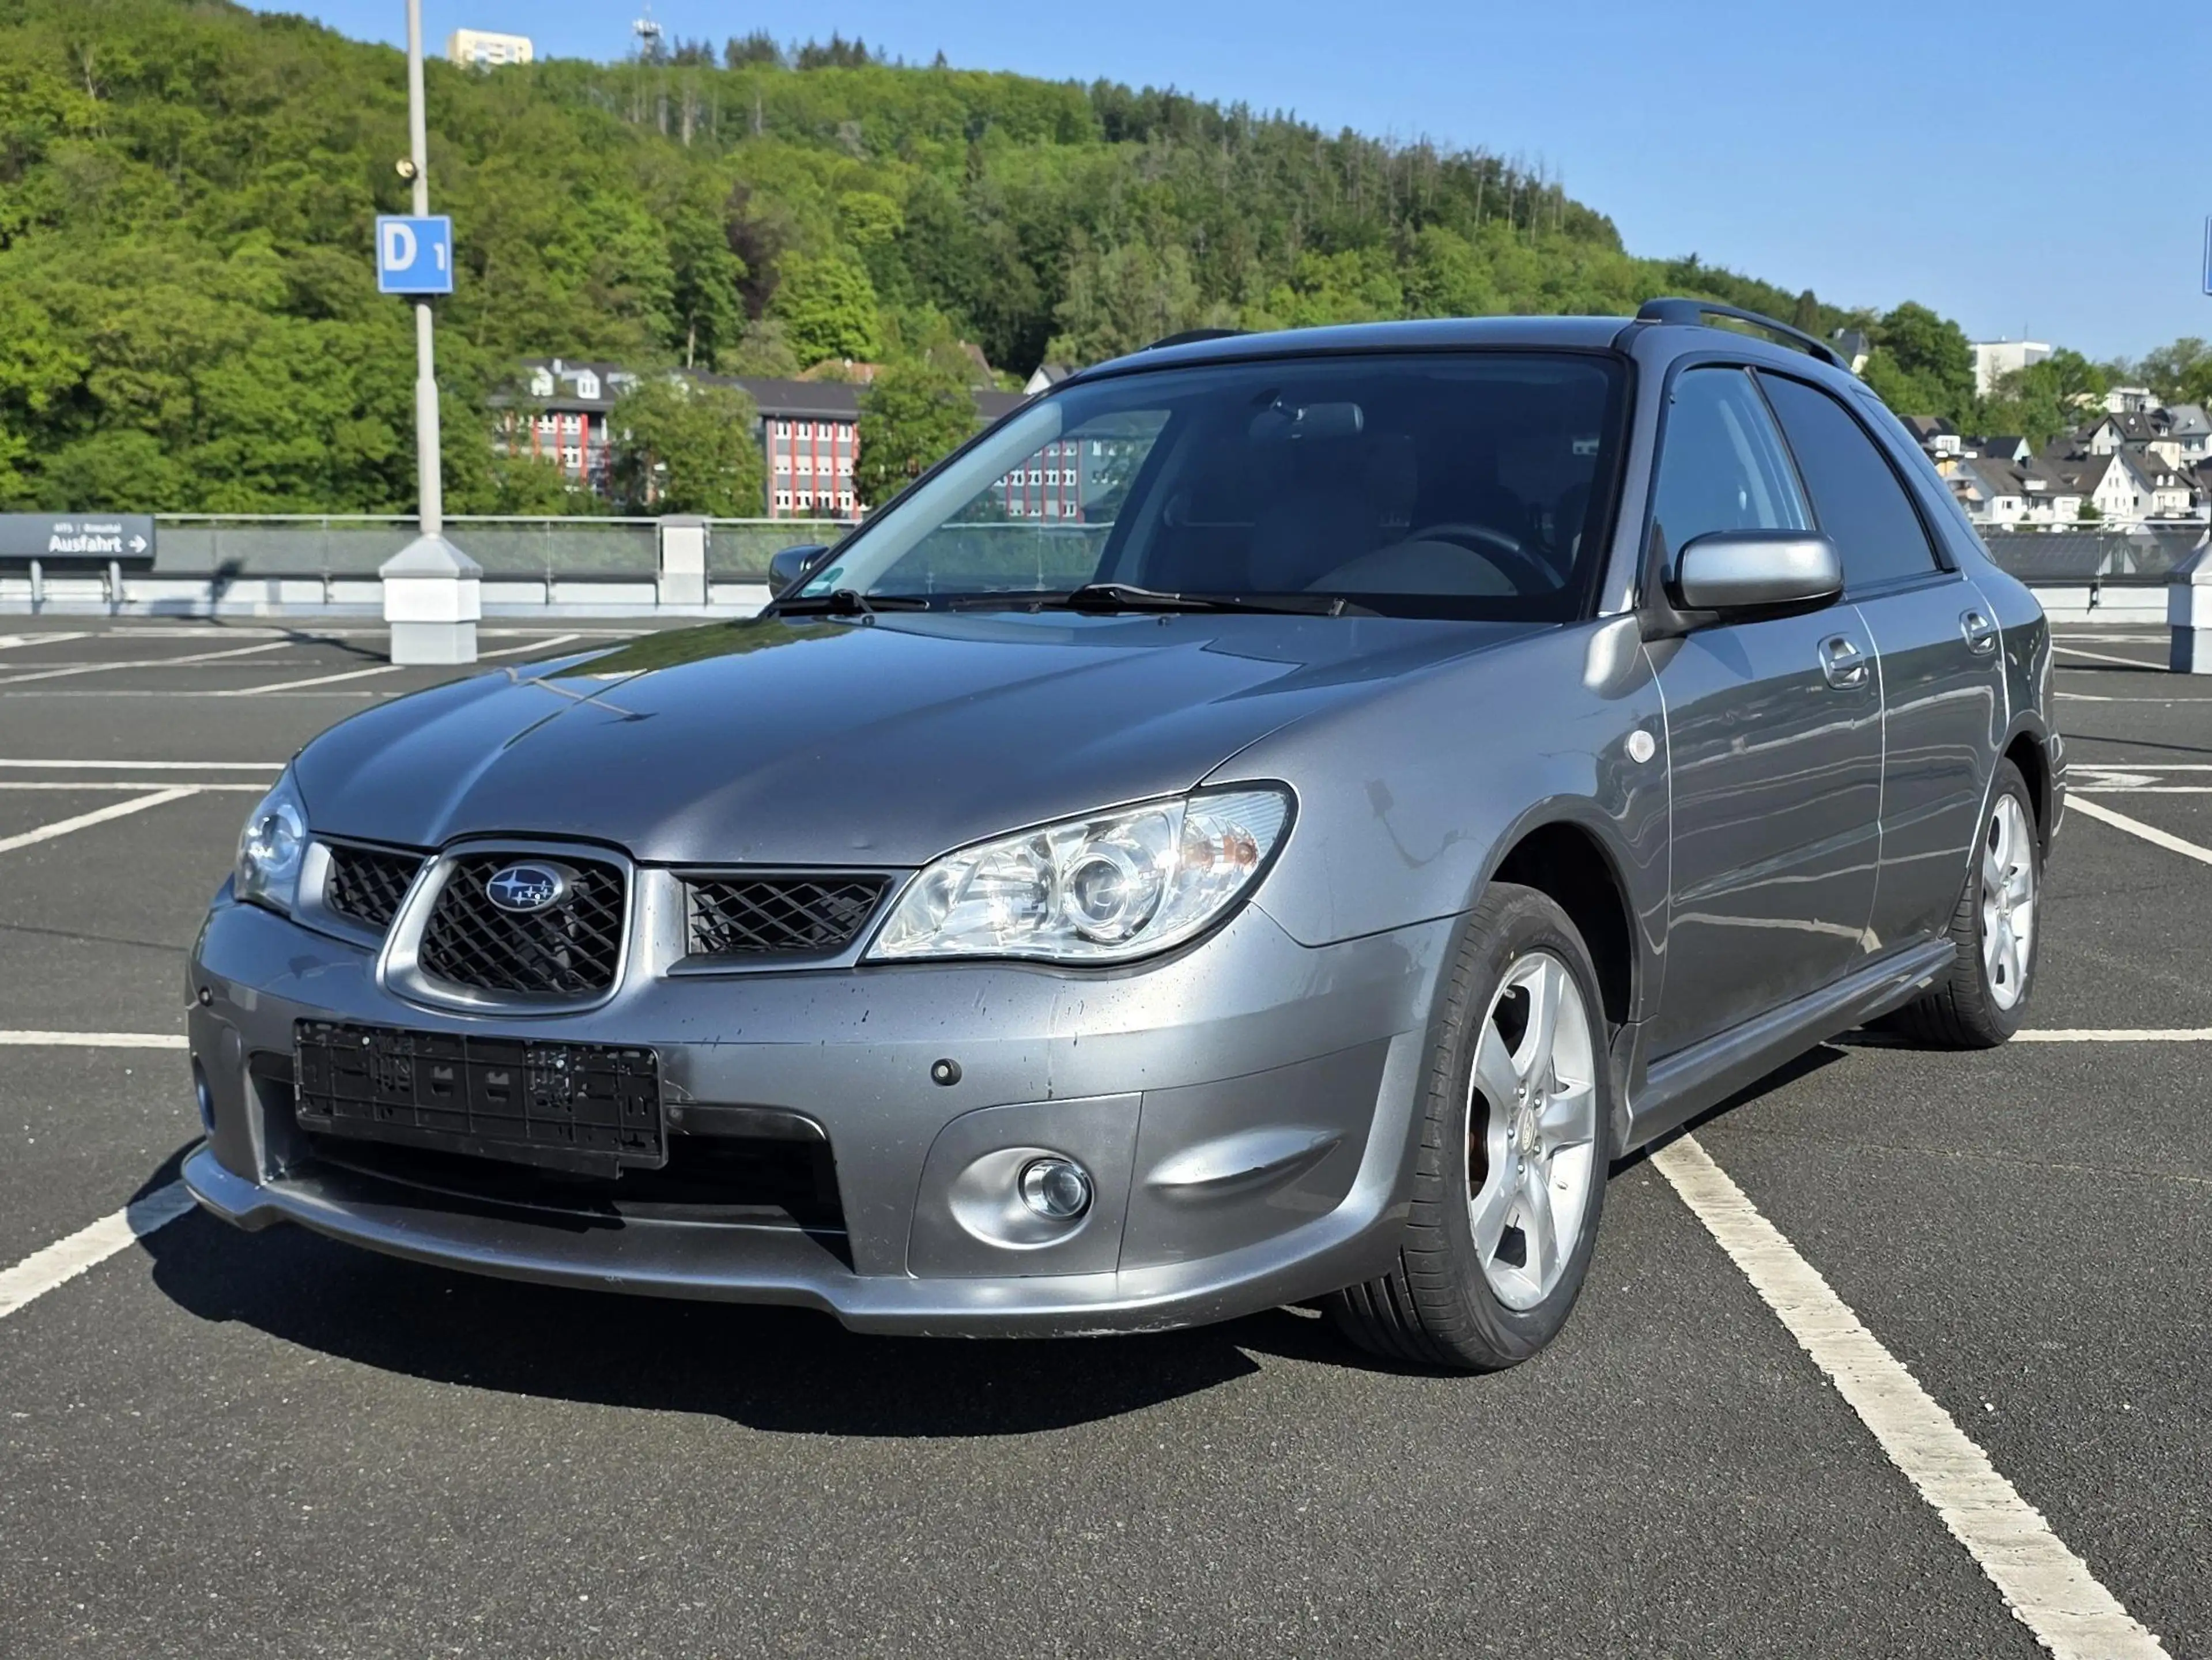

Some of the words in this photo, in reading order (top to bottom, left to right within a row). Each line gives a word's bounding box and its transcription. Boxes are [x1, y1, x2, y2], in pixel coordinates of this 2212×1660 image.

[383, 222, 417, 271] D
[433, 242, 446, 271] 1
[48, 534, 123, 553] Ausfahrt
